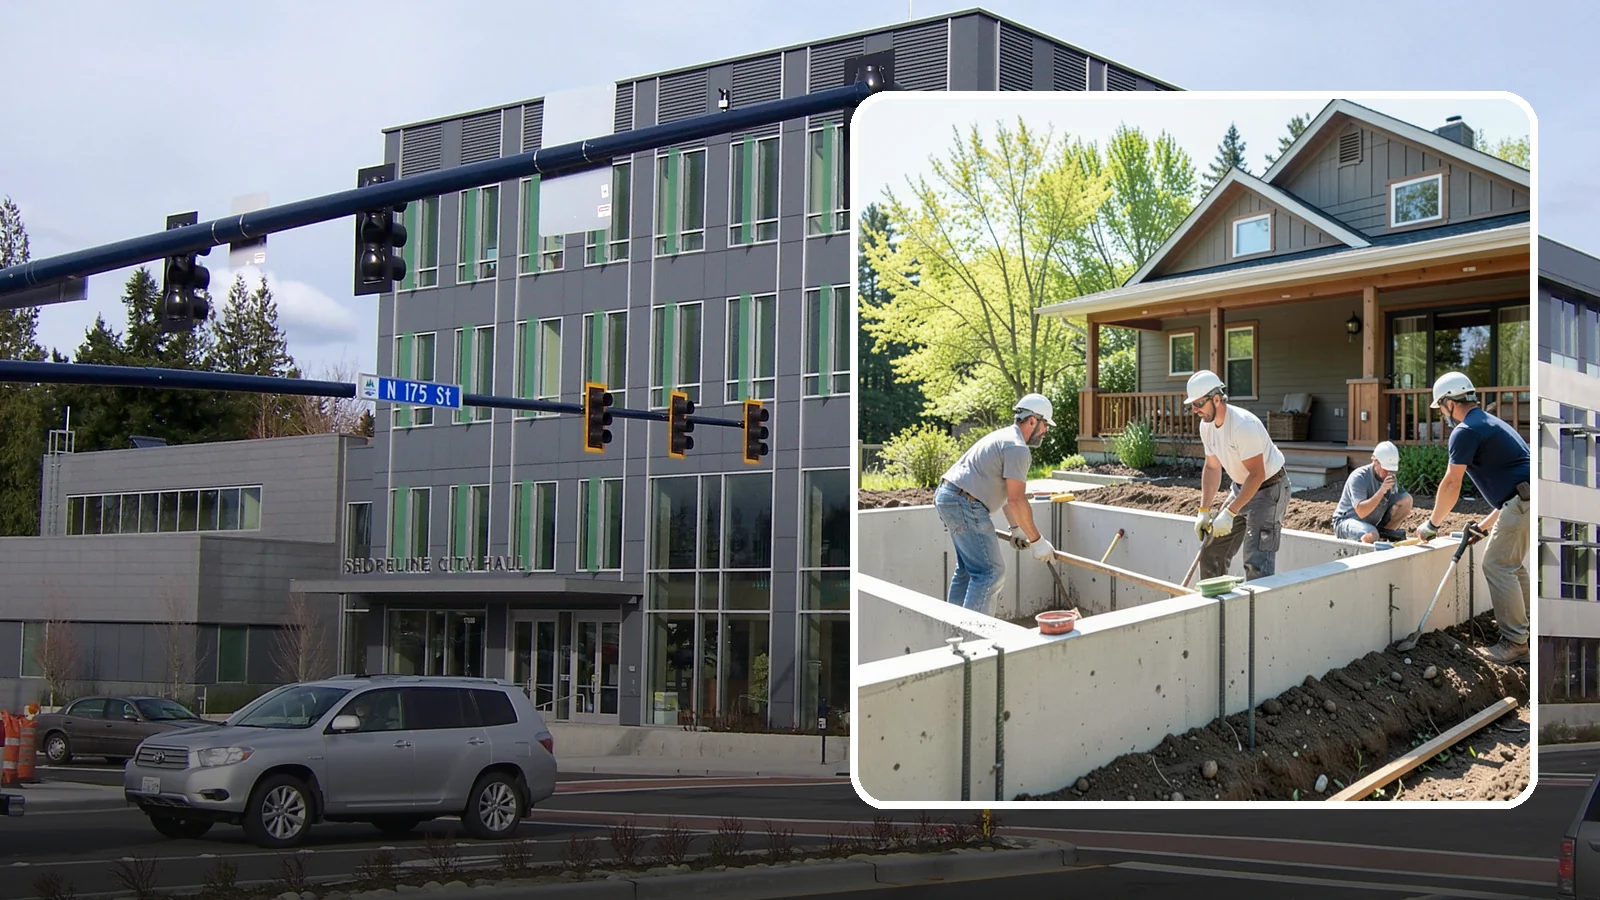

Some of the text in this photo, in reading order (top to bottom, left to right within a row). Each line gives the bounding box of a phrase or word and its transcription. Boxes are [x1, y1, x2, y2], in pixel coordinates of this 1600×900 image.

[387, 380, 451, 406] N 175 St
[343, 556, 525, 574] SHORELINE CITY HALL
